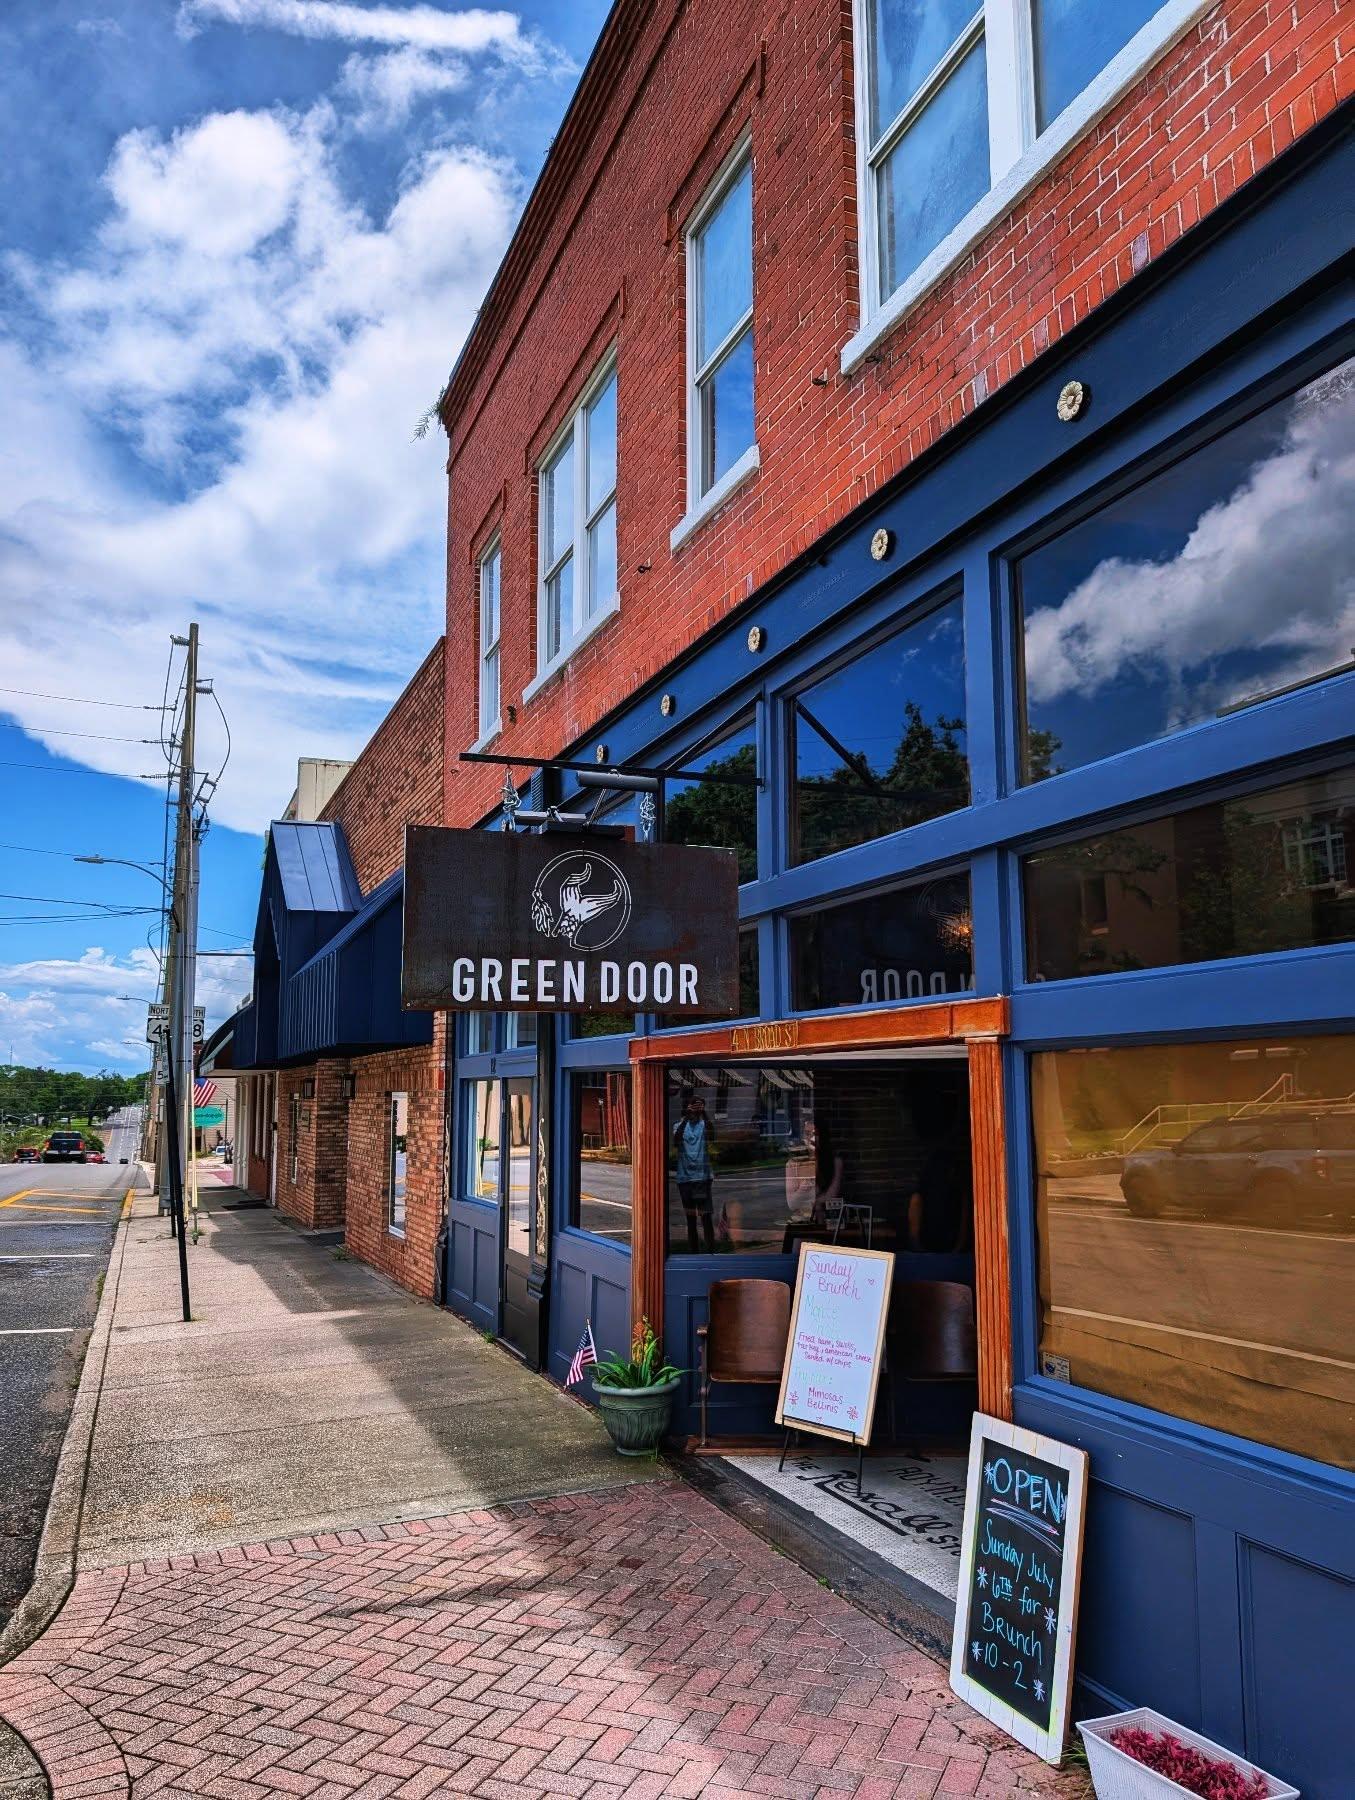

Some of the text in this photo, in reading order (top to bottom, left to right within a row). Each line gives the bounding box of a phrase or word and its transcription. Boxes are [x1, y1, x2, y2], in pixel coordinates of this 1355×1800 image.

[452, 958, 699, 1005] GREEN DOOR
[150, 1005, 170, 1016] NORT
[193, 1023, 202, 1038] 8
[810, 1254, 854, 1283] Sunday
[818, 1277, 861, 1301] Brunch
[807, 1398, 838, 1414] Bellinis
[809, 1387, 843, 1404] Mimosas
[795, 1470, 953, 1534] Rexall
[993, 1458, 1060, 1523] OPEN
[981, 1518, 1054, 1597] Sunday July
[1018, 1586, 1041, 1615] for
[984, 1643, 998, 1668] 10
[1013, 1661, 1028, 1689] 2
